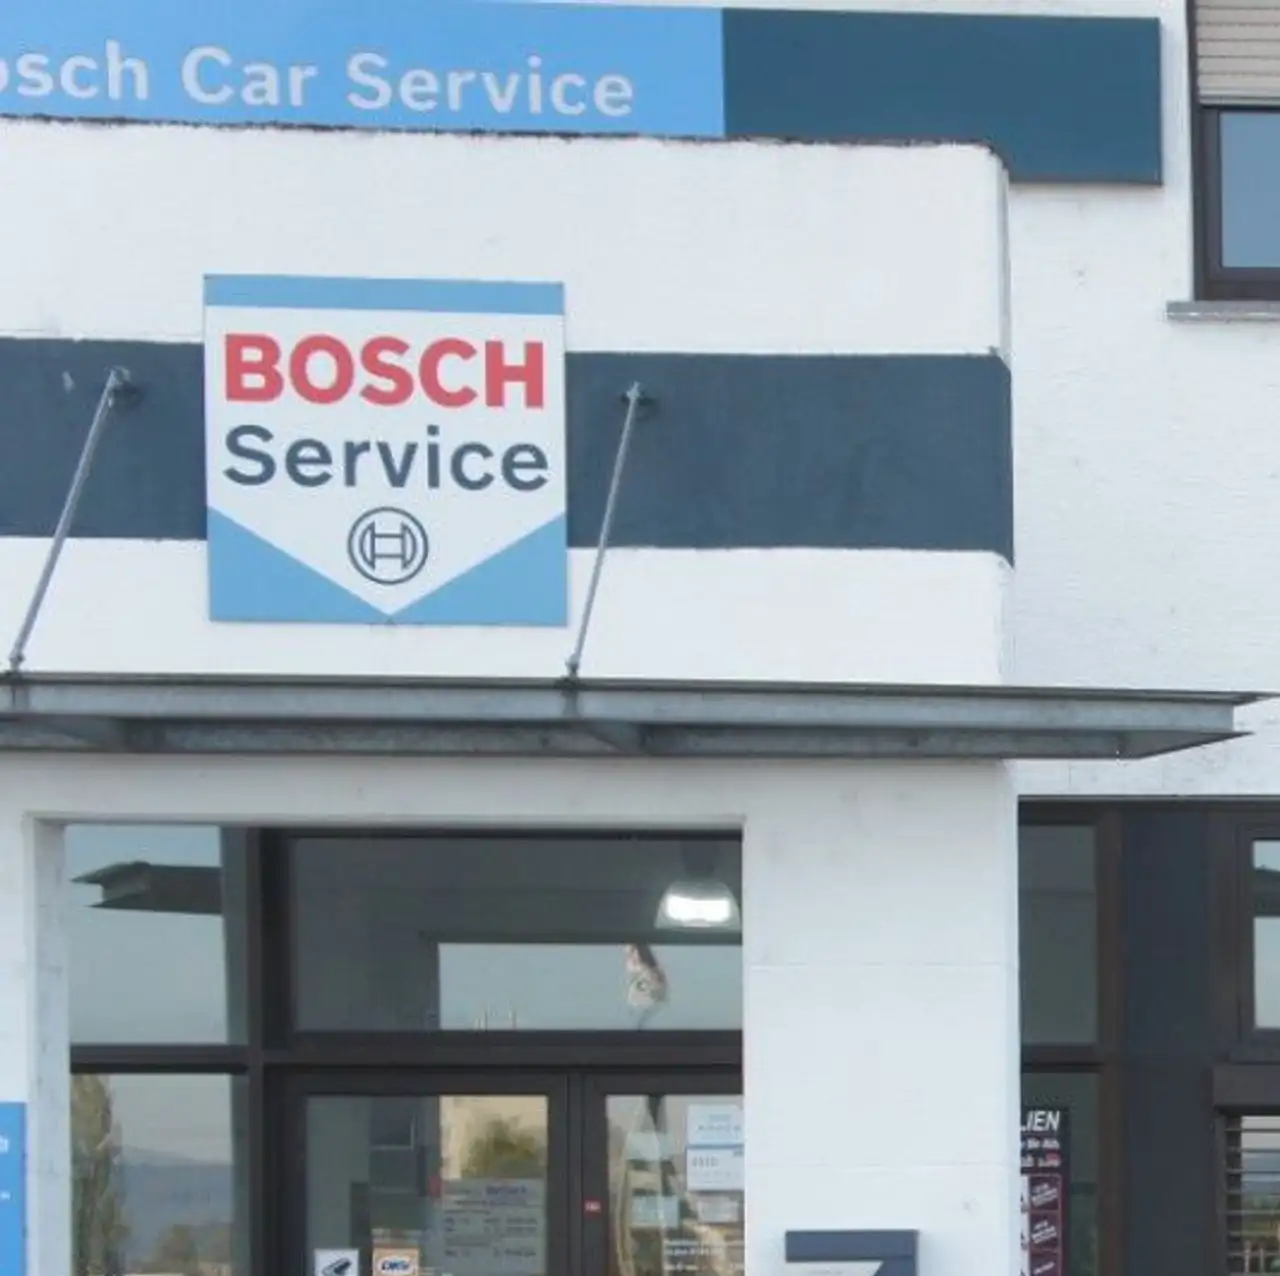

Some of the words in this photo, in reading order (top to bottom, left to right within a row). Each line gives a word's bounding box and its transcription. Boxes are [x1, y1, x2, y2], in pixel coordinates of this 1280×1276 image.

[0, 37, 149, 100] sch
[182, 47, 317, 107] Car
[347, 53, 634, 116] Service
[224, 333, 545, 409] BOSCH
[223, 425, 549, 491] Service
[1020, 1110, 1060, 1131] IEN
